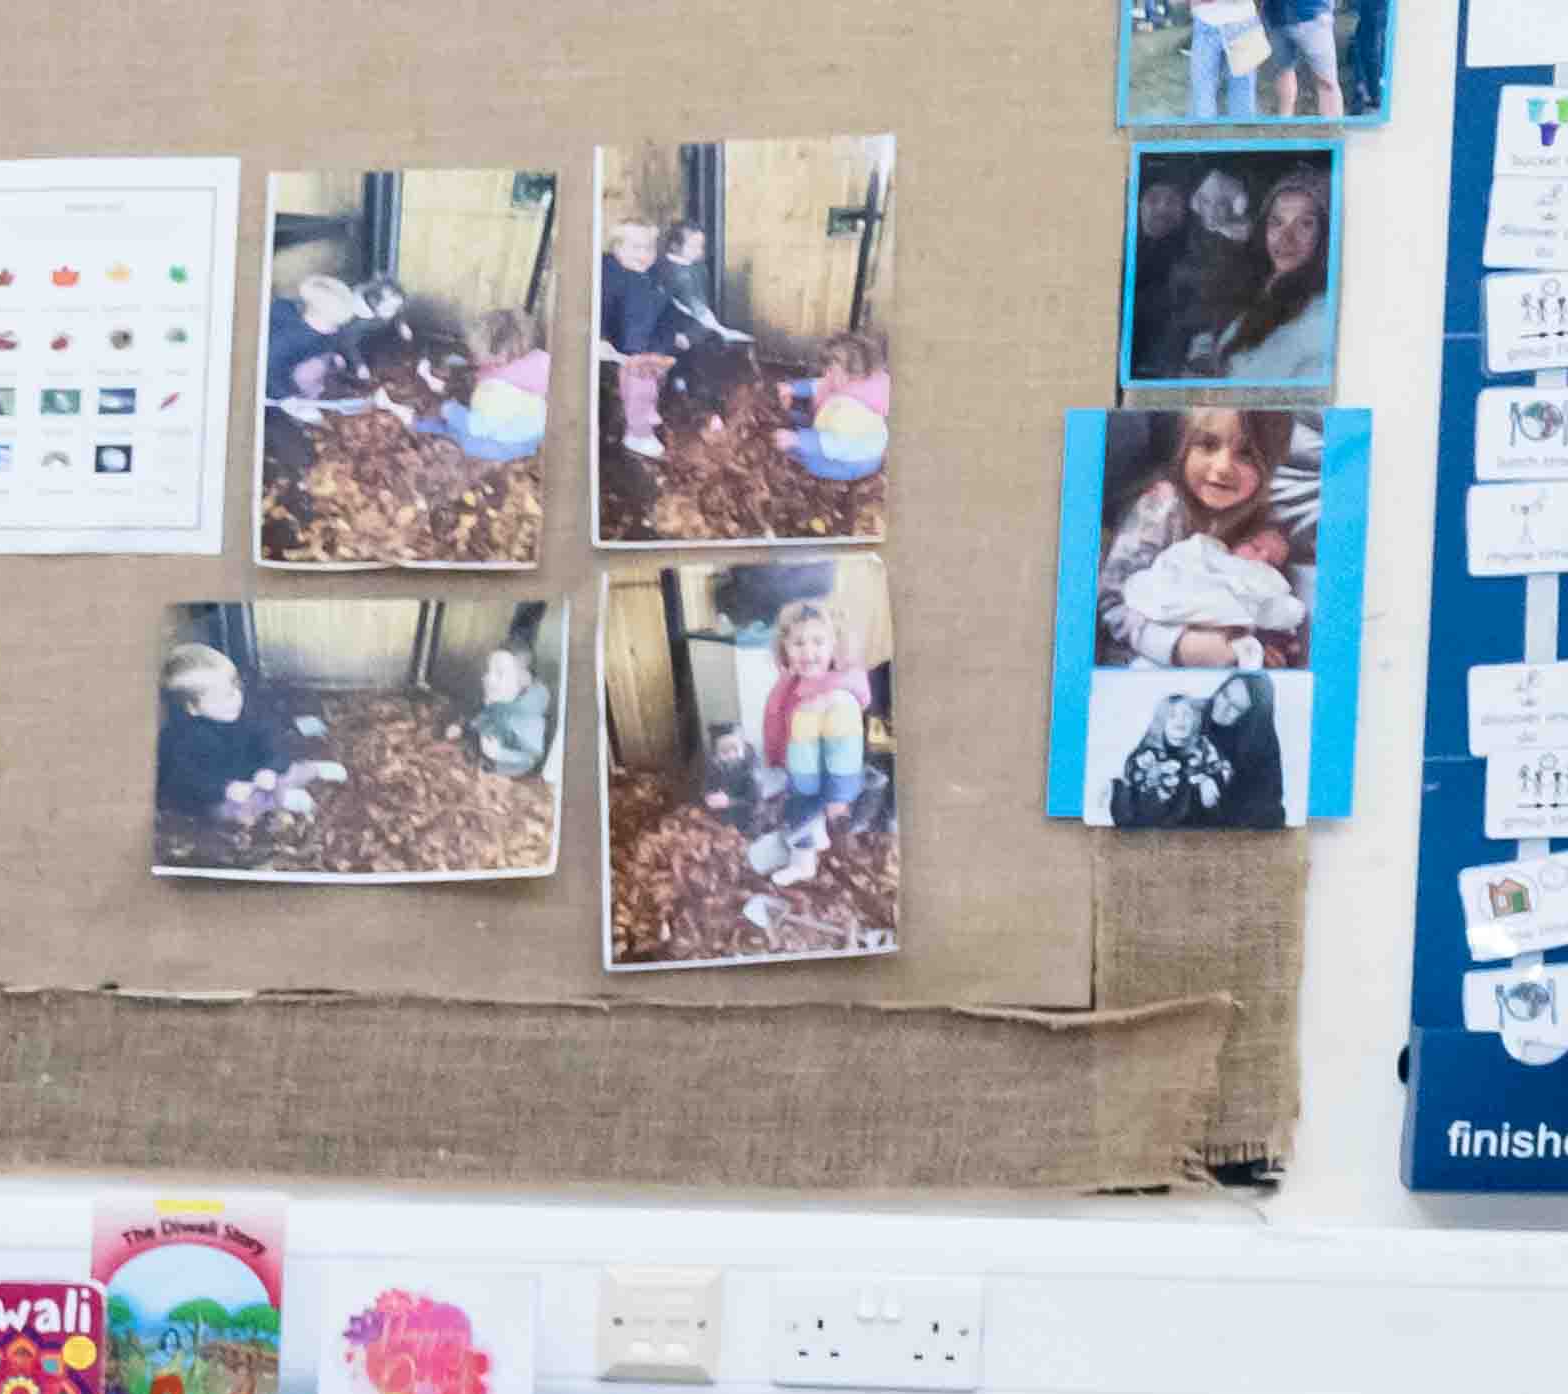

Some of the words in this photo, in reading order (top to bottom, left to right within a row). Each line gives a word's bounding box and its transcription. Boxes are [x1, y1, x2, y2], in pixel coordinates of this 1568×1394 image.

[1447, 1119, 1568, 1159] finish
[121, 1227, 156, 1246] The
[160, 1218, 218, 1237] Diwali
[224, 1224, 268, 1256] Story
